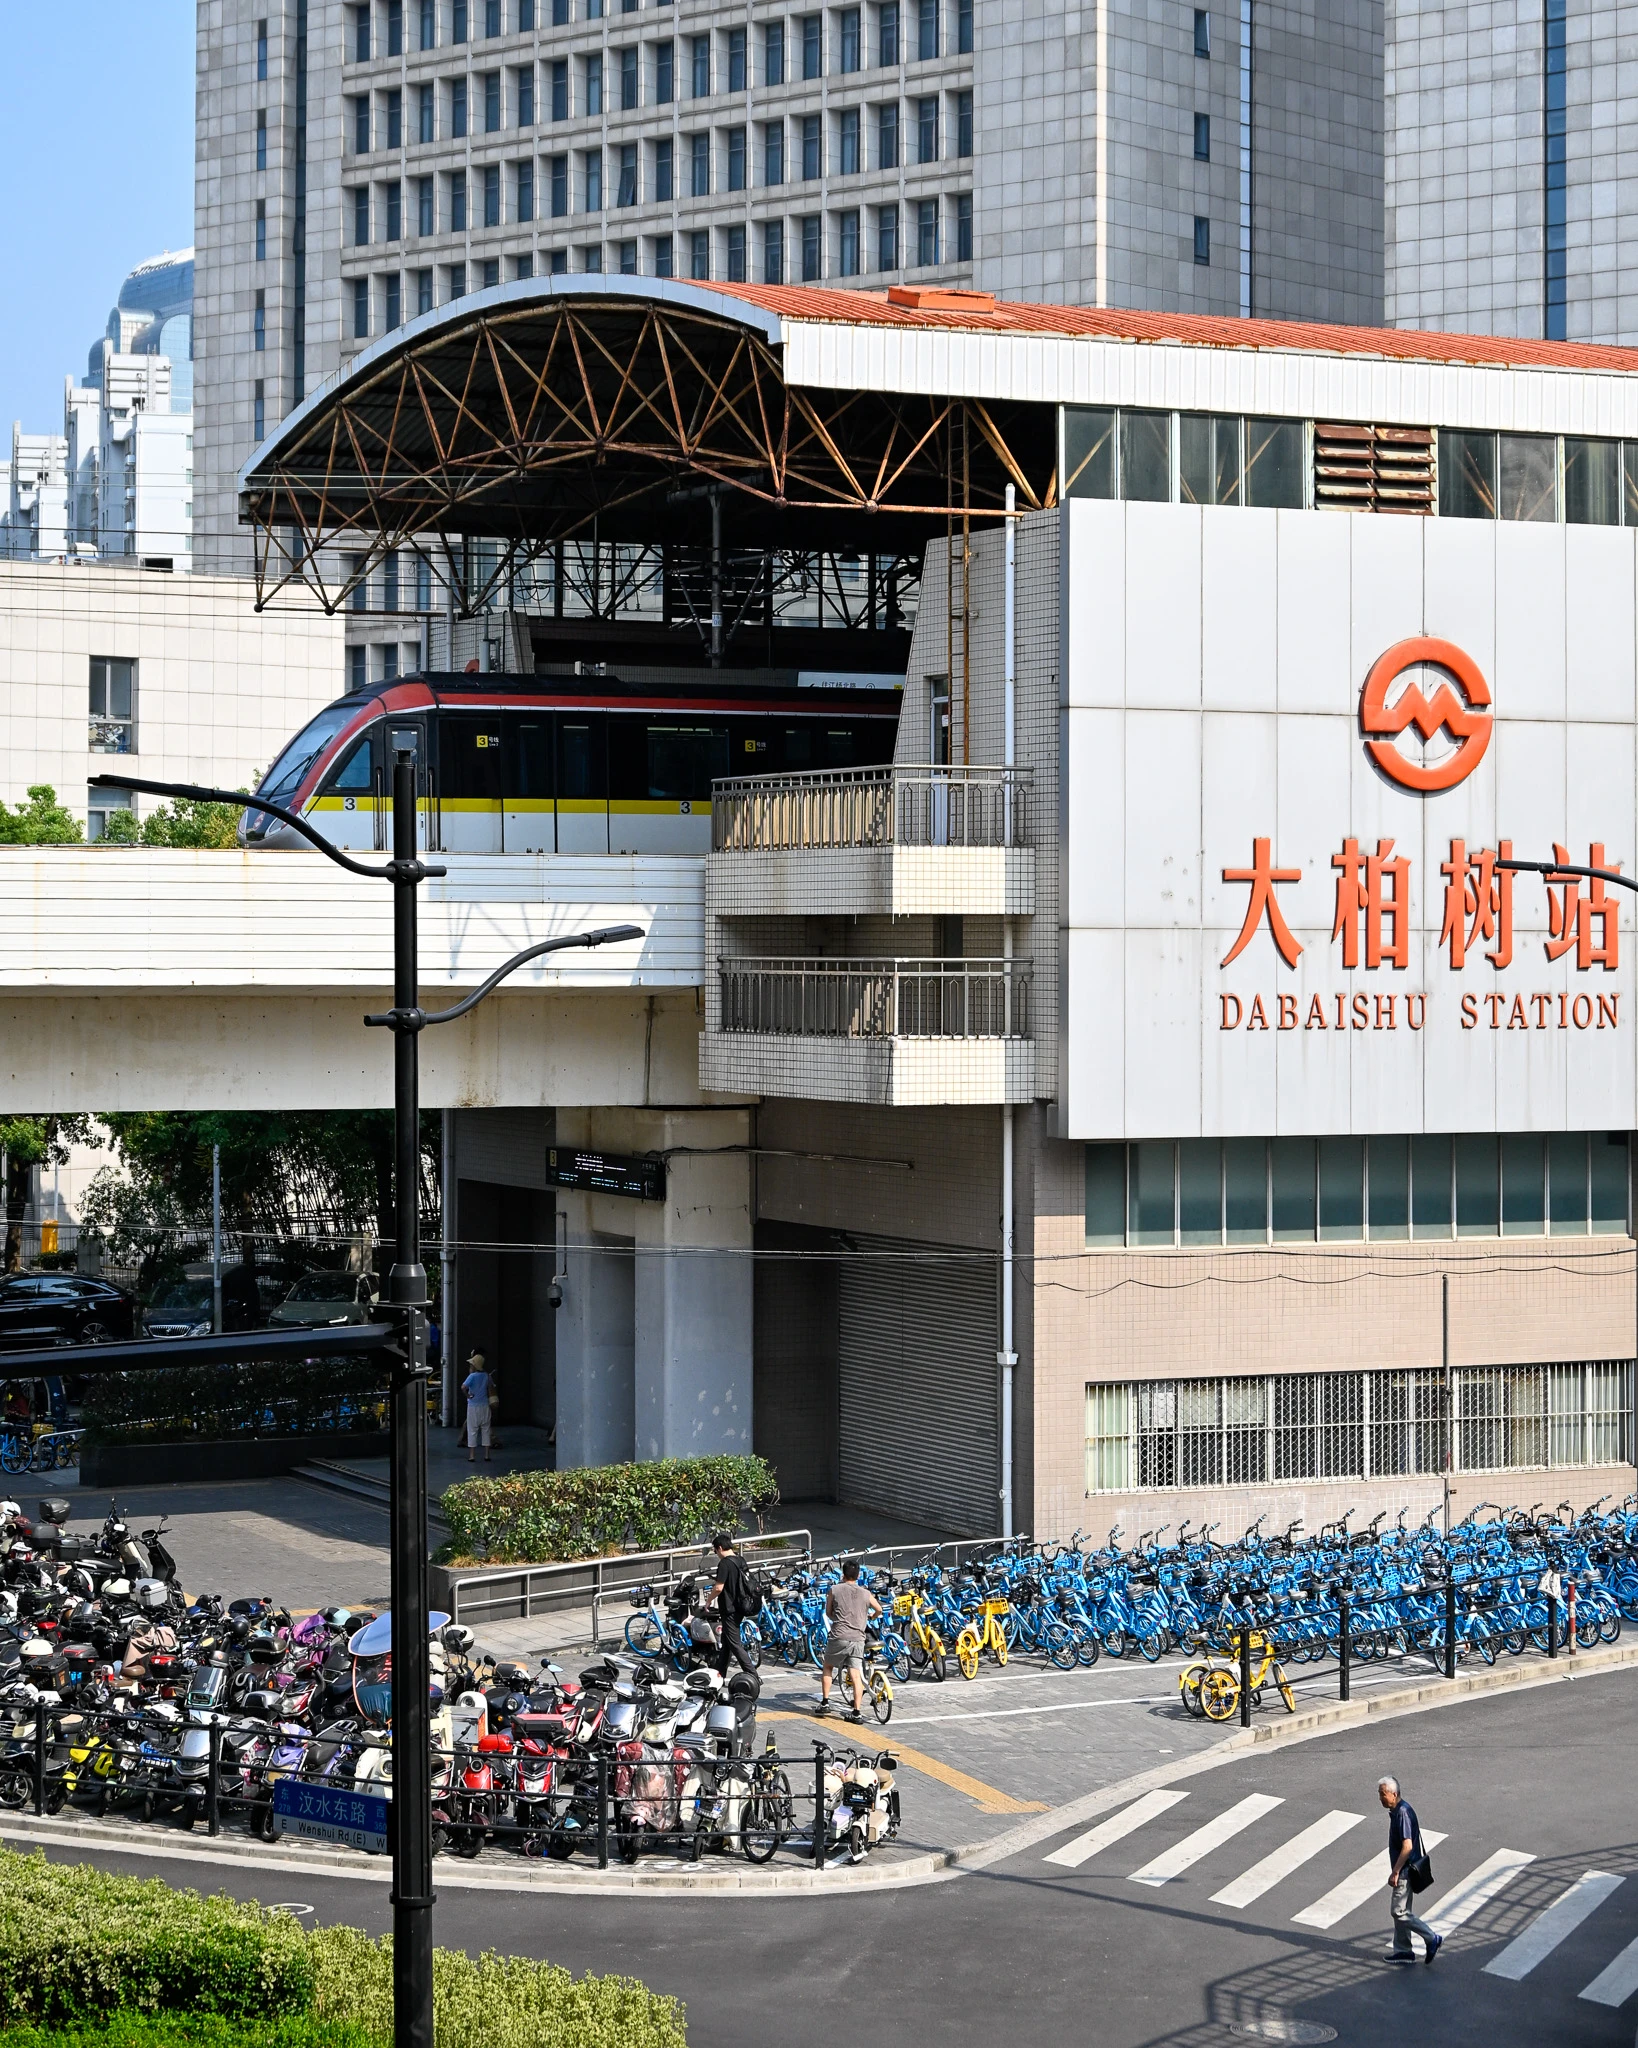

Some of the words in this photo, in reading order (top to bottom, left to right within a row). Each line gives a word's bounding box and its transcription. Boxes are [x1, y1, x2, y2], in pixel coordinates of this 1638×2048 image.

[344, 797, 356, 811] 3
[680, 801, 691, 815] 3
[1221, 837, 1621, 969] 大柏树站
[1220, 993, 1428, 1030] DABAISHU
[1460, 992, 1620, 1030] STATION
[281, 1787, 290, 1800] 东
[278, 1803, 291, 1813] 278
[298, 1791, 367, 1825] 汶水东路
[375, 1805, 385, 1819] 西
[281, 1819, 288, 1830] E
[298, 1822, 336, 1838] Wenshui
[337, 1829, 367, 1846] Rd.(E)
[376, 1836, 385, 1848] W
[374, 1821, 387, 1832] 350
